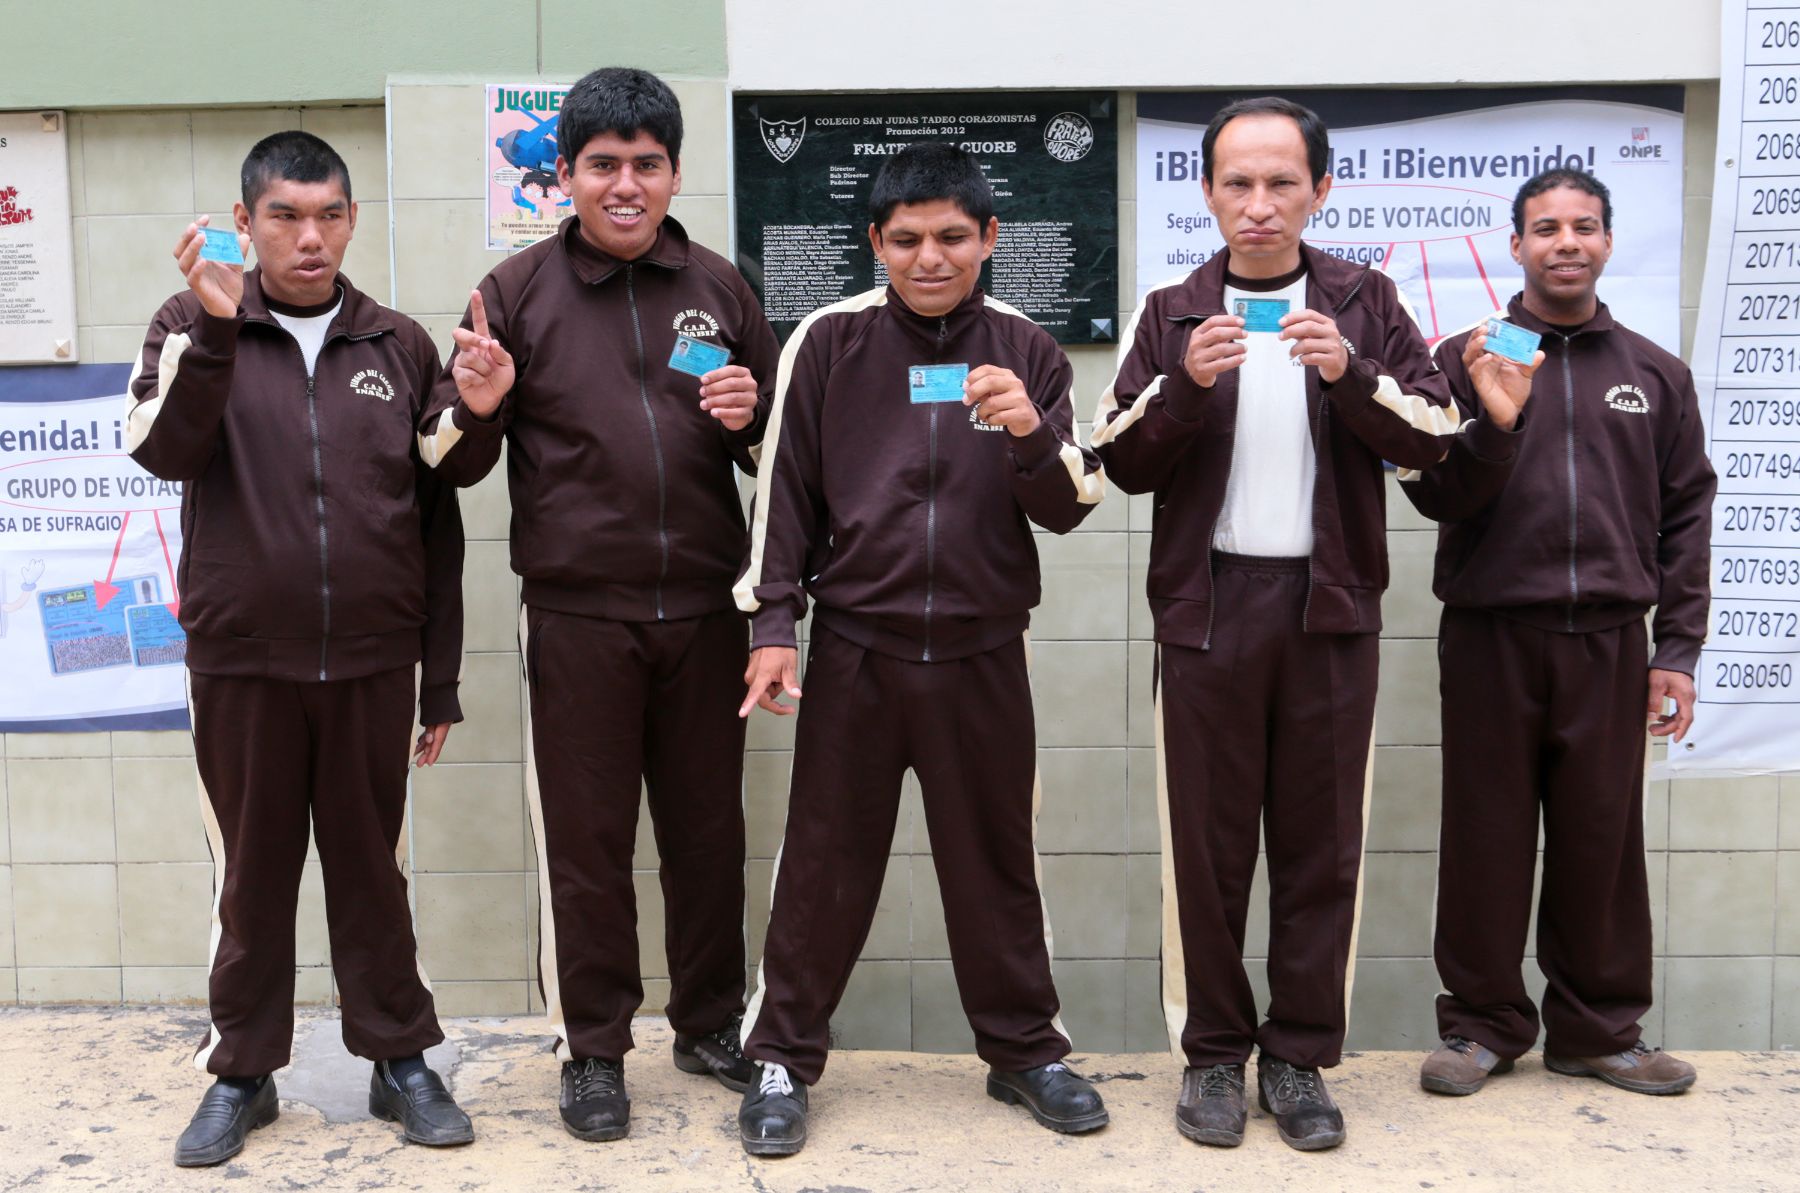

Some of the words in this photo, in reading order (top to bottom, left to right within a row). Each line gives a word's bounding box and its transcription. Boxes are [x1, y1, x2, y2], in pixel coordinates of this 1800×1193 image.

[1759, 77, 1800, 104] 206
[815, 117, 860, 126] COLEGIO
[863, 117, 882, 125] SAN
[886, 116, 919, 125] JUDAS
[921, 115, 956, 125] TADEO
[958, 114, 1037, 124] CORAZONISTAS
[885, 127, 938, 136] Promoción
[940, 126, 966, 135] 2012
[853, 143, 912, 155] FRATE
[959, 141, 1017, 154] CUORE
[1619, 144, 1662, 158] ONPE
[1382, 144, 1596, 179] ¡Bienvenido!
[1167, 213, 1211, 233] Según
[1348, 207, 1375, 228] DE
[1383, 199, 1491, 228] VOTACIÓN
[1167, 249, 1205, 265] ubica
[1733, 347, 1800, 373] 20731
[0, 420, 99, 452] enida!
[7, 478, 77, 499] GRUPO
[84, 477, 110, 498] DE
[22, 517, 42, 532] DE
[47, 516, 121, 532] SUFRAGIO
[1724, 505, 1800, 532] 207573
[1720, 558, 1800, 585] 207693
[1718, 610, 1797, 637] 207872
[1716, 662, 1792, 688] 208050
